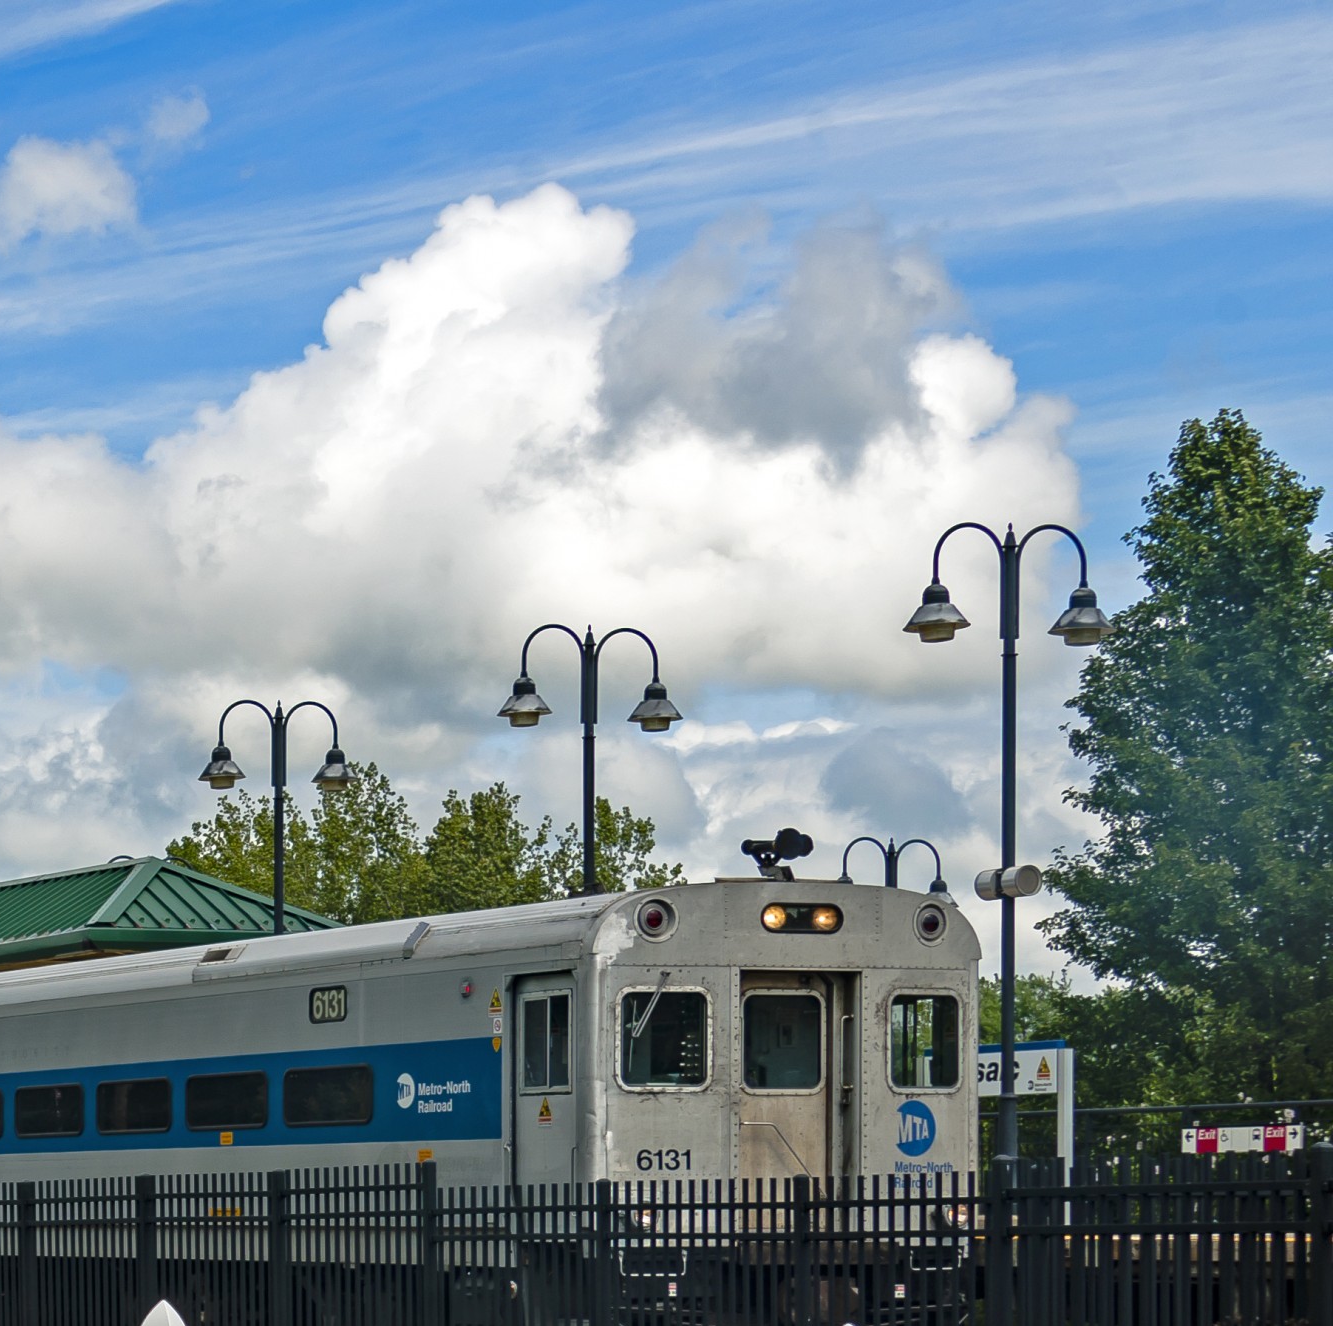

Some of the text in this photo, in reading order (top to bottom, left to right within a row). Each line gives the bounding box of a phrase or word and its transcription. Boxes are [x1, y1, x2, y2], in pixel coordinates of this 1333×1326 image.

[313, 990, 345, 1020] 6131
[417, 1080, 471, 1096] Metro-North
[417, 1098, 453, 1113] Railroad
[1198, 1129, 1216, 1140] Exit
[1265, 1127, 1285, 1138] Exit
[636, 1149, 691, 1171] 6131
[894, 1160, 953, 1173] Metro-North
